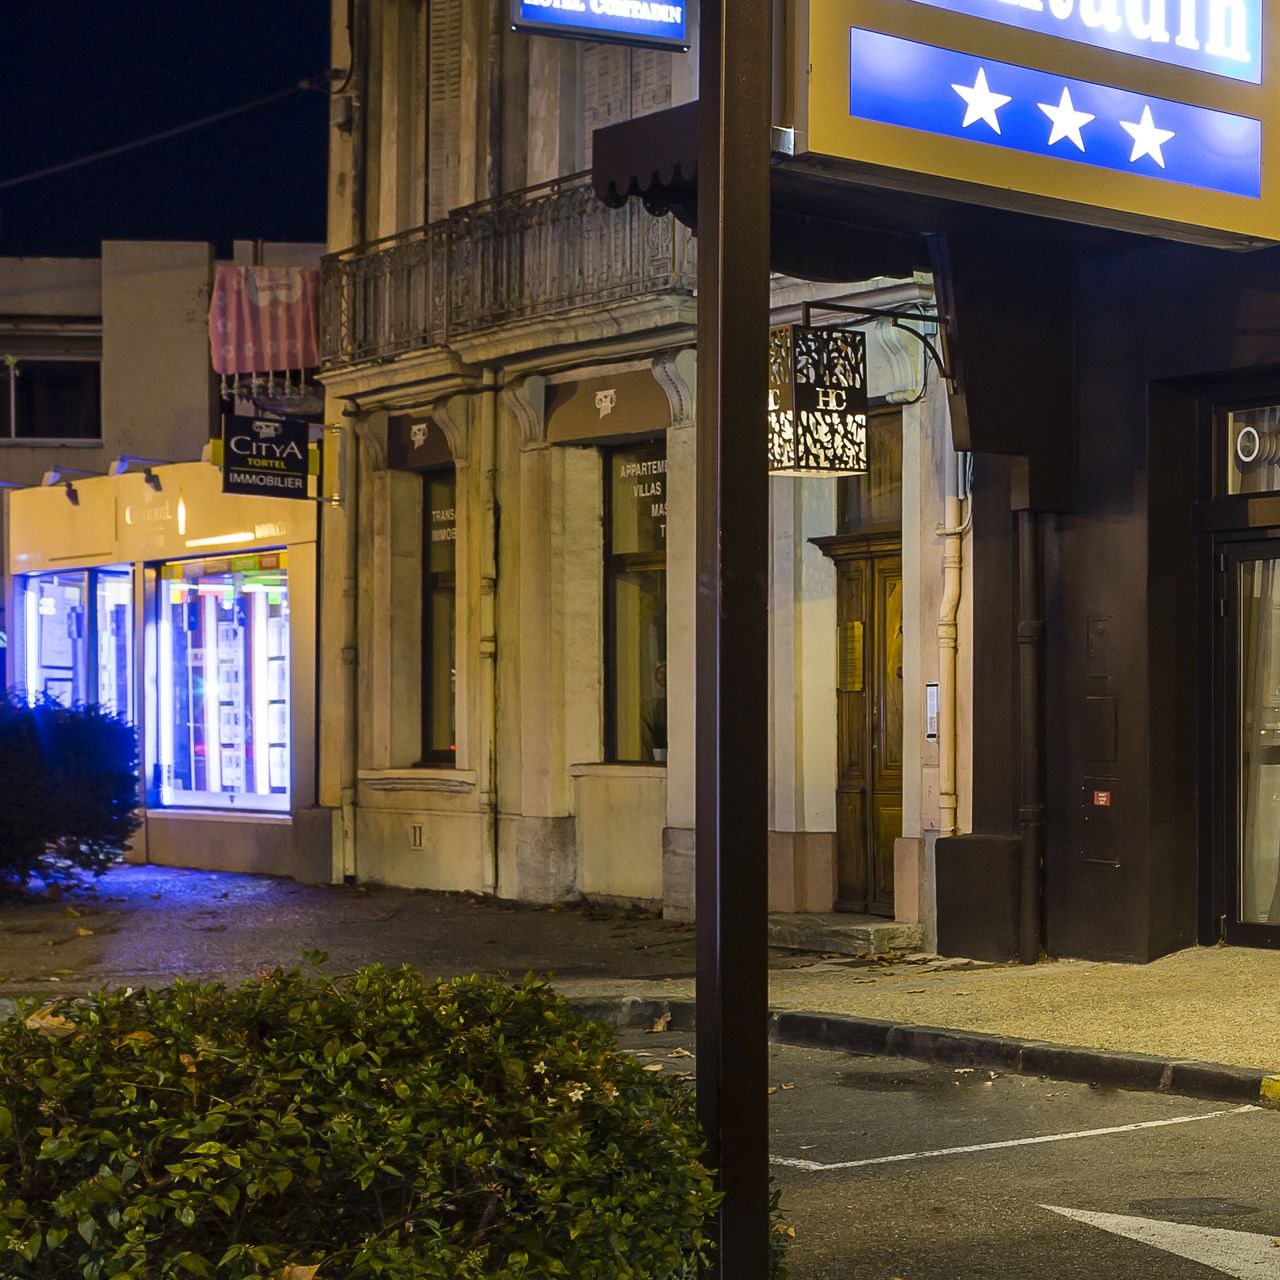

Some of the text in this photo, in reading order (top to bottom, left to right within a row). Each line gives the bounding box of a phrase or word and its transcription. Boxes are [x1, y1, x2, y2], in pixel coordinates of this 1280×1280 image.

[816, 387, 847, 410] HC
[247, 458, 287, 469] TORTEL
[229, 473, 303, 489] IMMOBILIER
[633, 482, 661, 497] VILLAS
